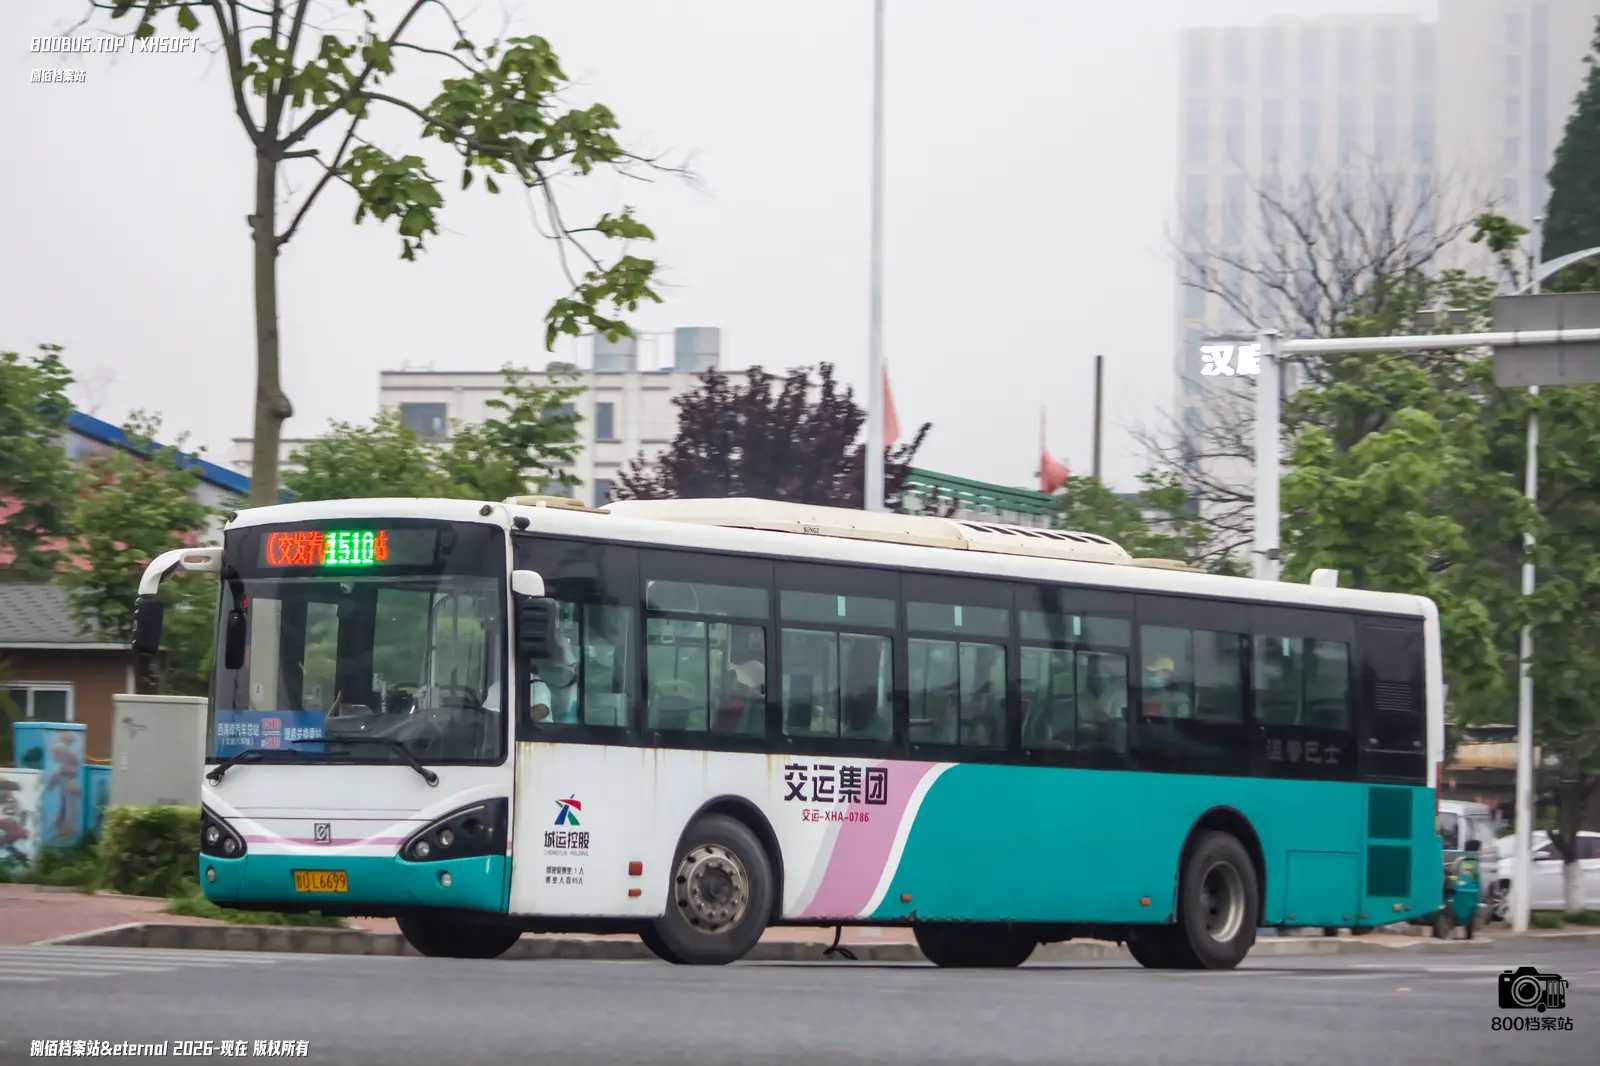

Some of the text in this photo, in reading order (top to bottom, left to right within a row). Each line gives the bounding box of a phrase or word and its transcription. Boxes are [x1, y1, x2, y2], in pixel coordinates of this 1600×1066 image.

[784, 763, 888, 805] 交运集团
[801, 808, 870, 823] 交运-XHA-0786
[544, 830, 590, 849] 城运控股
